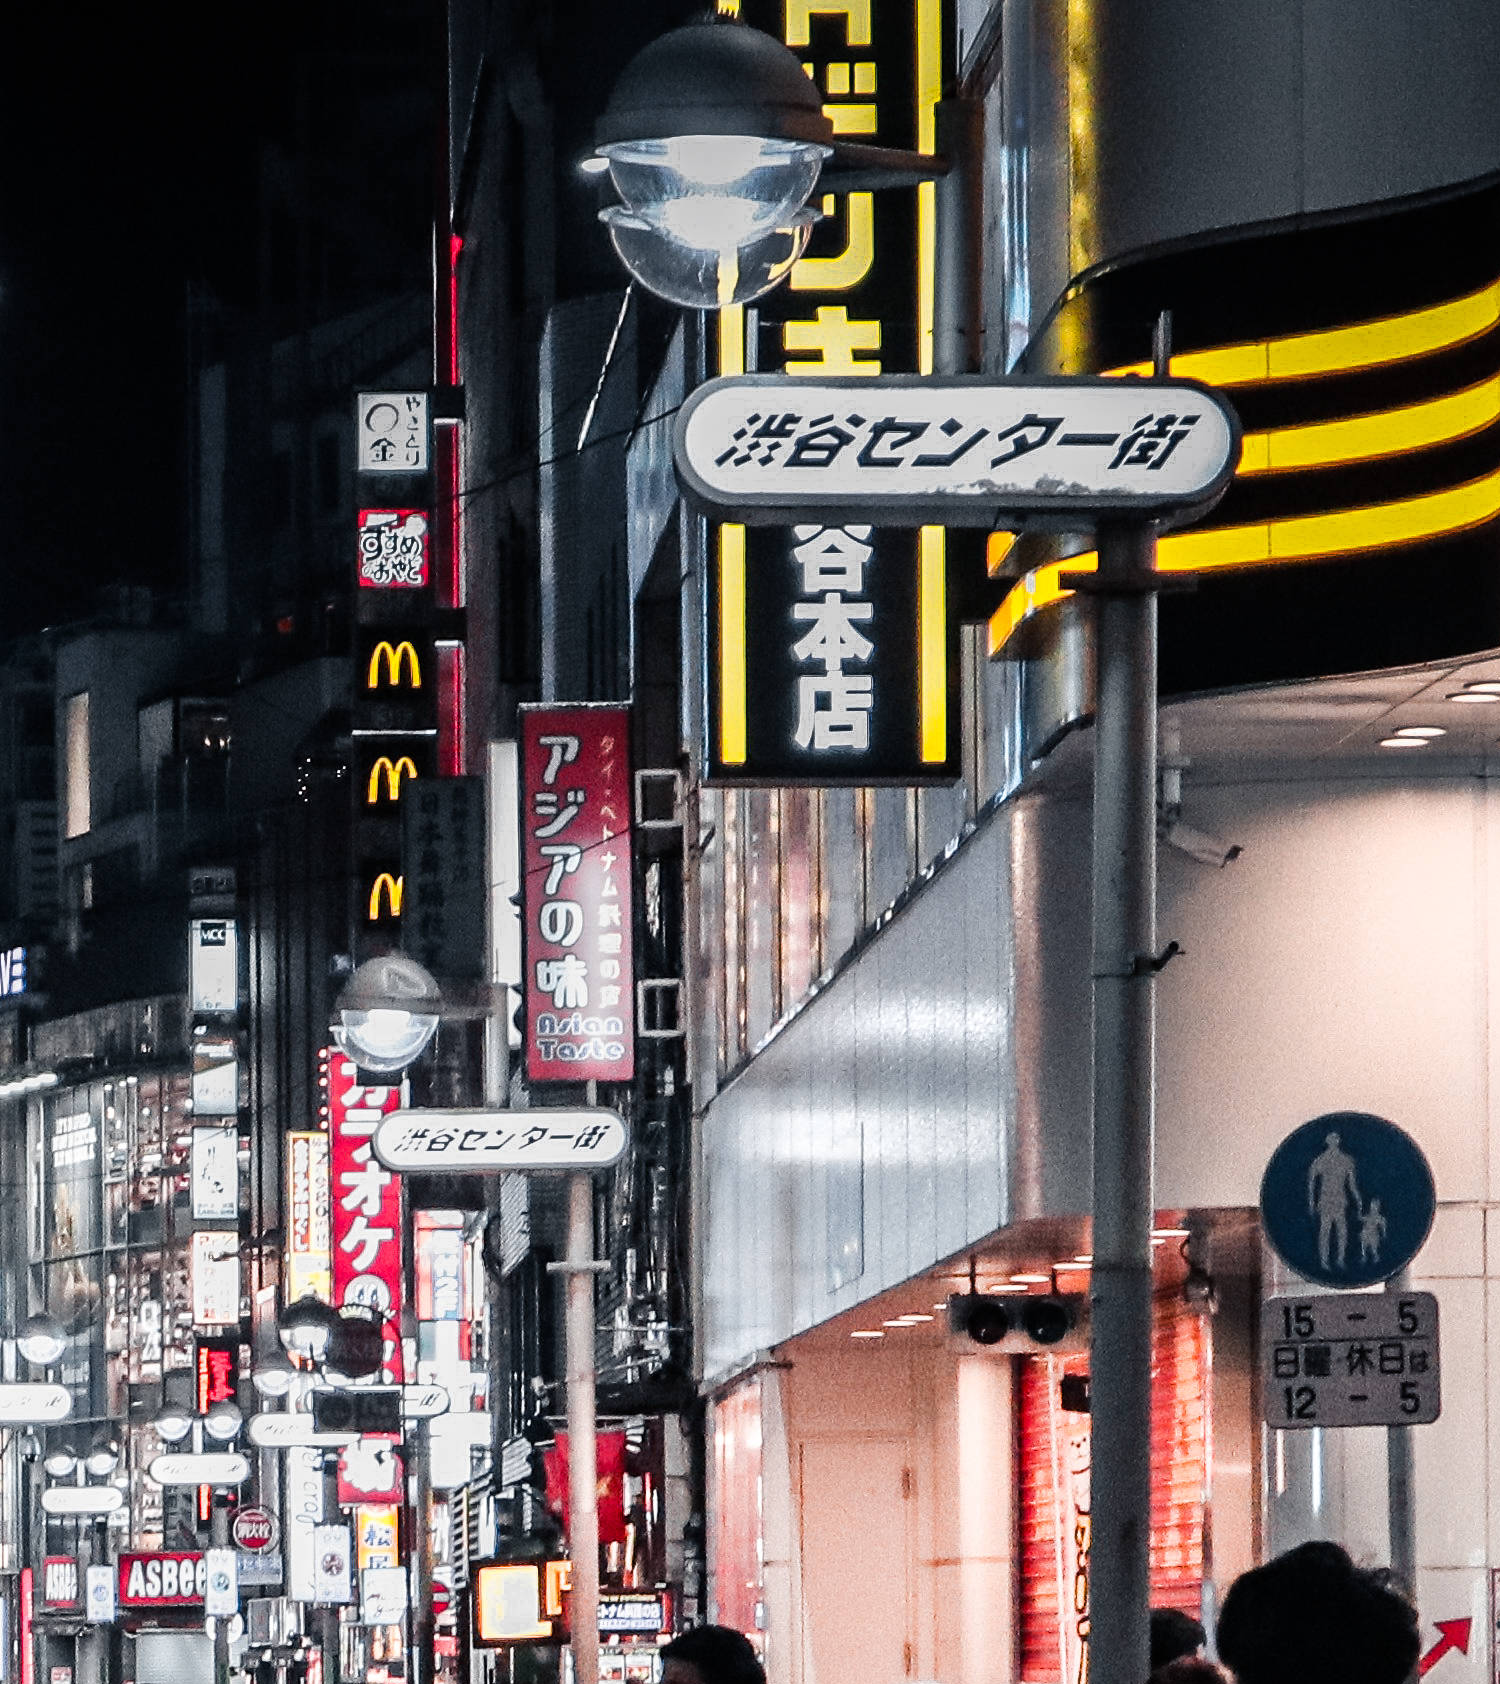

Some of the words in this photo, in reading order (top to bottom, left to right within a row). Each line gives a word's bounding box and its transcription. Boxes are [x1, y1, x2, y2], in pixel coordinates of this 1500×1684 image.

[714, 412, 1201, 471] 渋谷センター街
[793, 525, 875, 752] 谷本店
[533, 736, 590, 1010] アジアの味
[537, 1011, 623, 1037] Asian
[537, 1036, 625, 1063] Taste
[394, 1126, 608, 1153] 渋谷センター街
[1283, 1304, 1315, 1338] 15
[1398, 1301, 1419, 1333] 5
[1284, 1387, 1317, 1420] 12
[1400, 1381, 1420, 1414] 5
